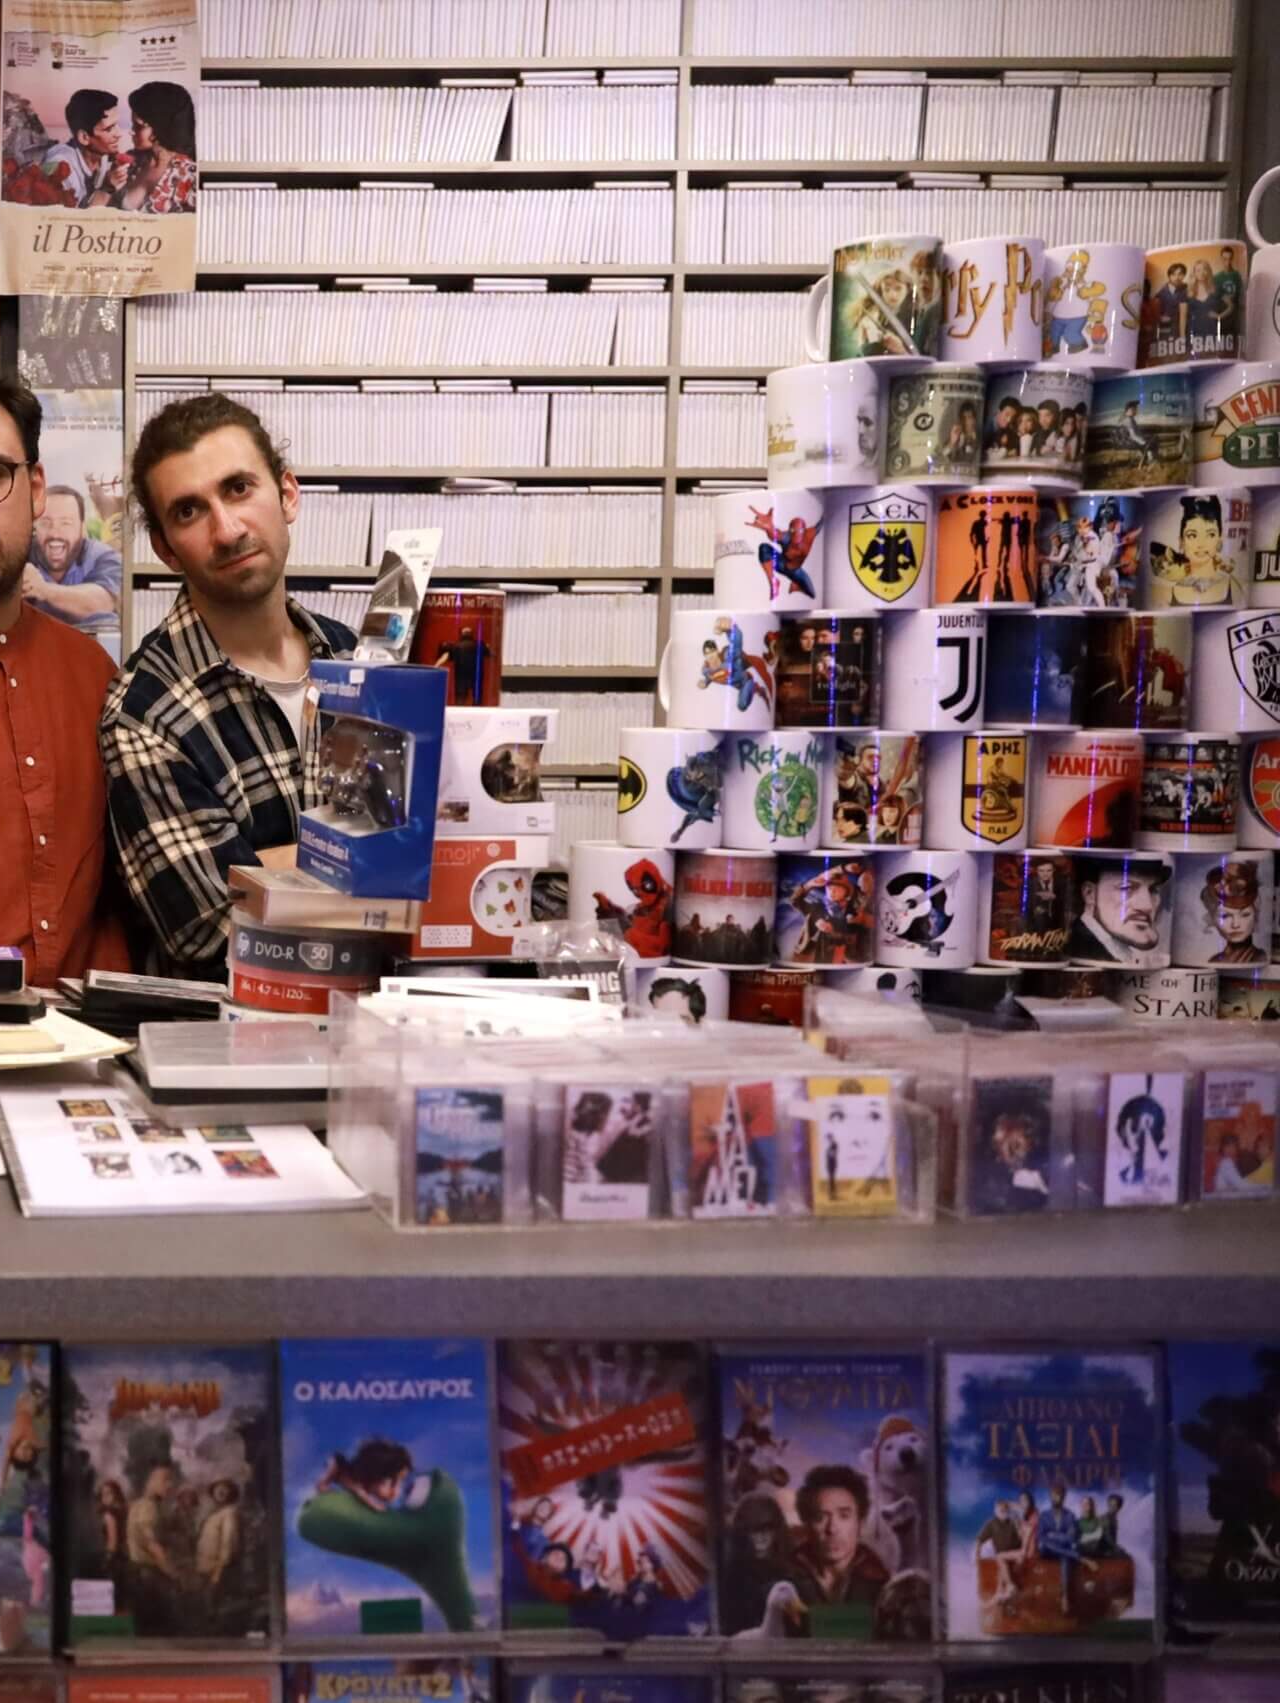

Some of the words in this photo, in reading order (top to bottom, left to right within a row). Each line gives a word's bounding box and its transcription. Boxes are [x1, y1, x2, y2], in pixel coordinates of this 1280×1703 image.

[32, 224, 53, 253] il
[60, 224, 163, 255] Postino
[434, 842, 477, 866] moji
[254, 941, 295, 961] DVD-R
[310, 946, 327, 961] 50
[285, 987, 304, 1001] 120
[293, 1380, 313, 1403] Ο
[319, 1377, 474, 1402] ΚΑΛΟΣΑΥΡΟΣ
[982, 1423, 1120, 1459] ΤΑΞΙΔΙ
